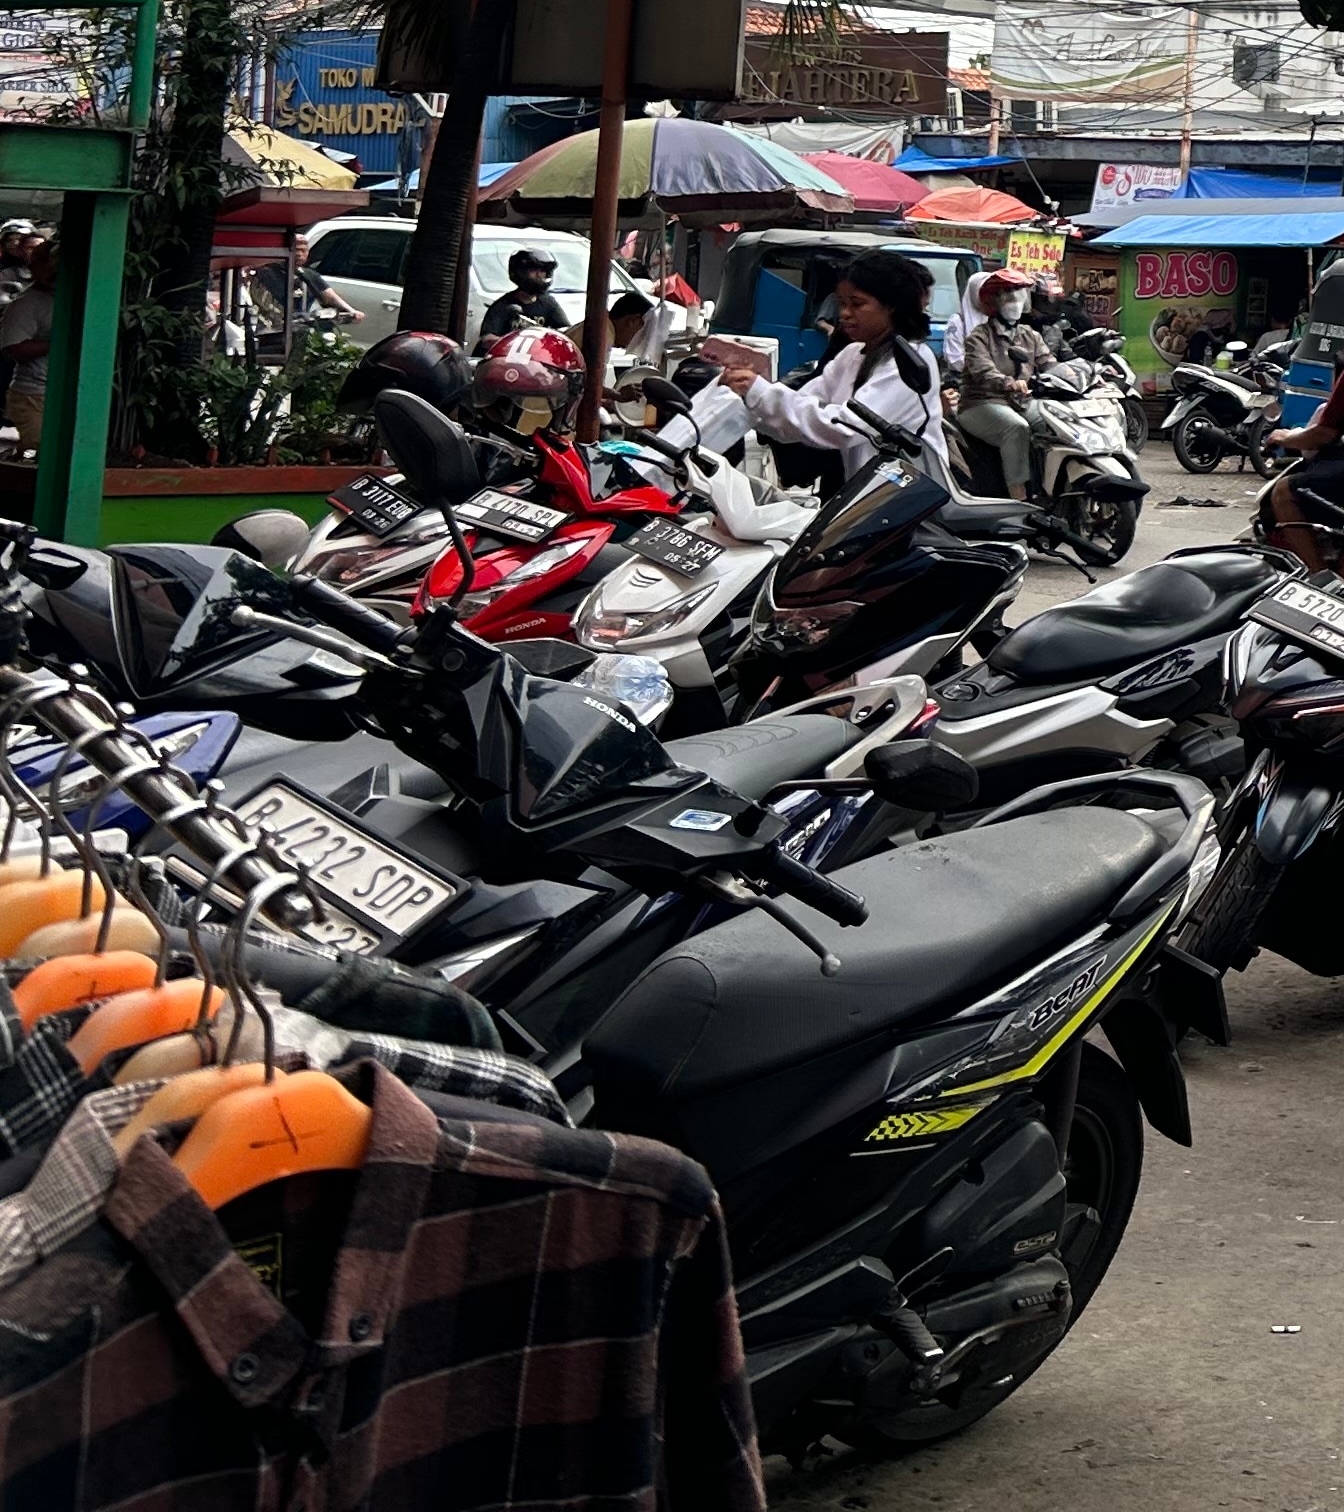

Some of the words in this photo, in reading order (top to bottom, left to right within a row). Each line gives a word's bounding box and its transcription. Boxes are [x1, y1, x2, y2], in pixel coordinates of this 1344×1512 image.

[319, 68, 356, 88] TOKO
[361, 67, 376, 88] M
[744, 68, 920, 104] EJAHTERA
[298, 101, 409, 136] SAMUDRA
[1010, 240, 1022, 258] Es
[1134, 251, 1239, 299] BASO
[362, 485, 395, 506] 3117
[492, 497, 530, 516] 4170
[642, 520, 660, 532] B
[656, 526, 693, 548] 3786
[691, 540, 721, 561] SFM
[1278, 586, 1297, 602] B
[1298, 593, 1344, 622] 5720
[504, 617, 547, 635] HONDA
[583, 696, 637, 734] HONDA
[243, 796, 284, 828] B
[271, 816, 367, 880] 4232
[352, 865, 434, 920] SDP
[1027, 954, 1108, 1031] BeAT
